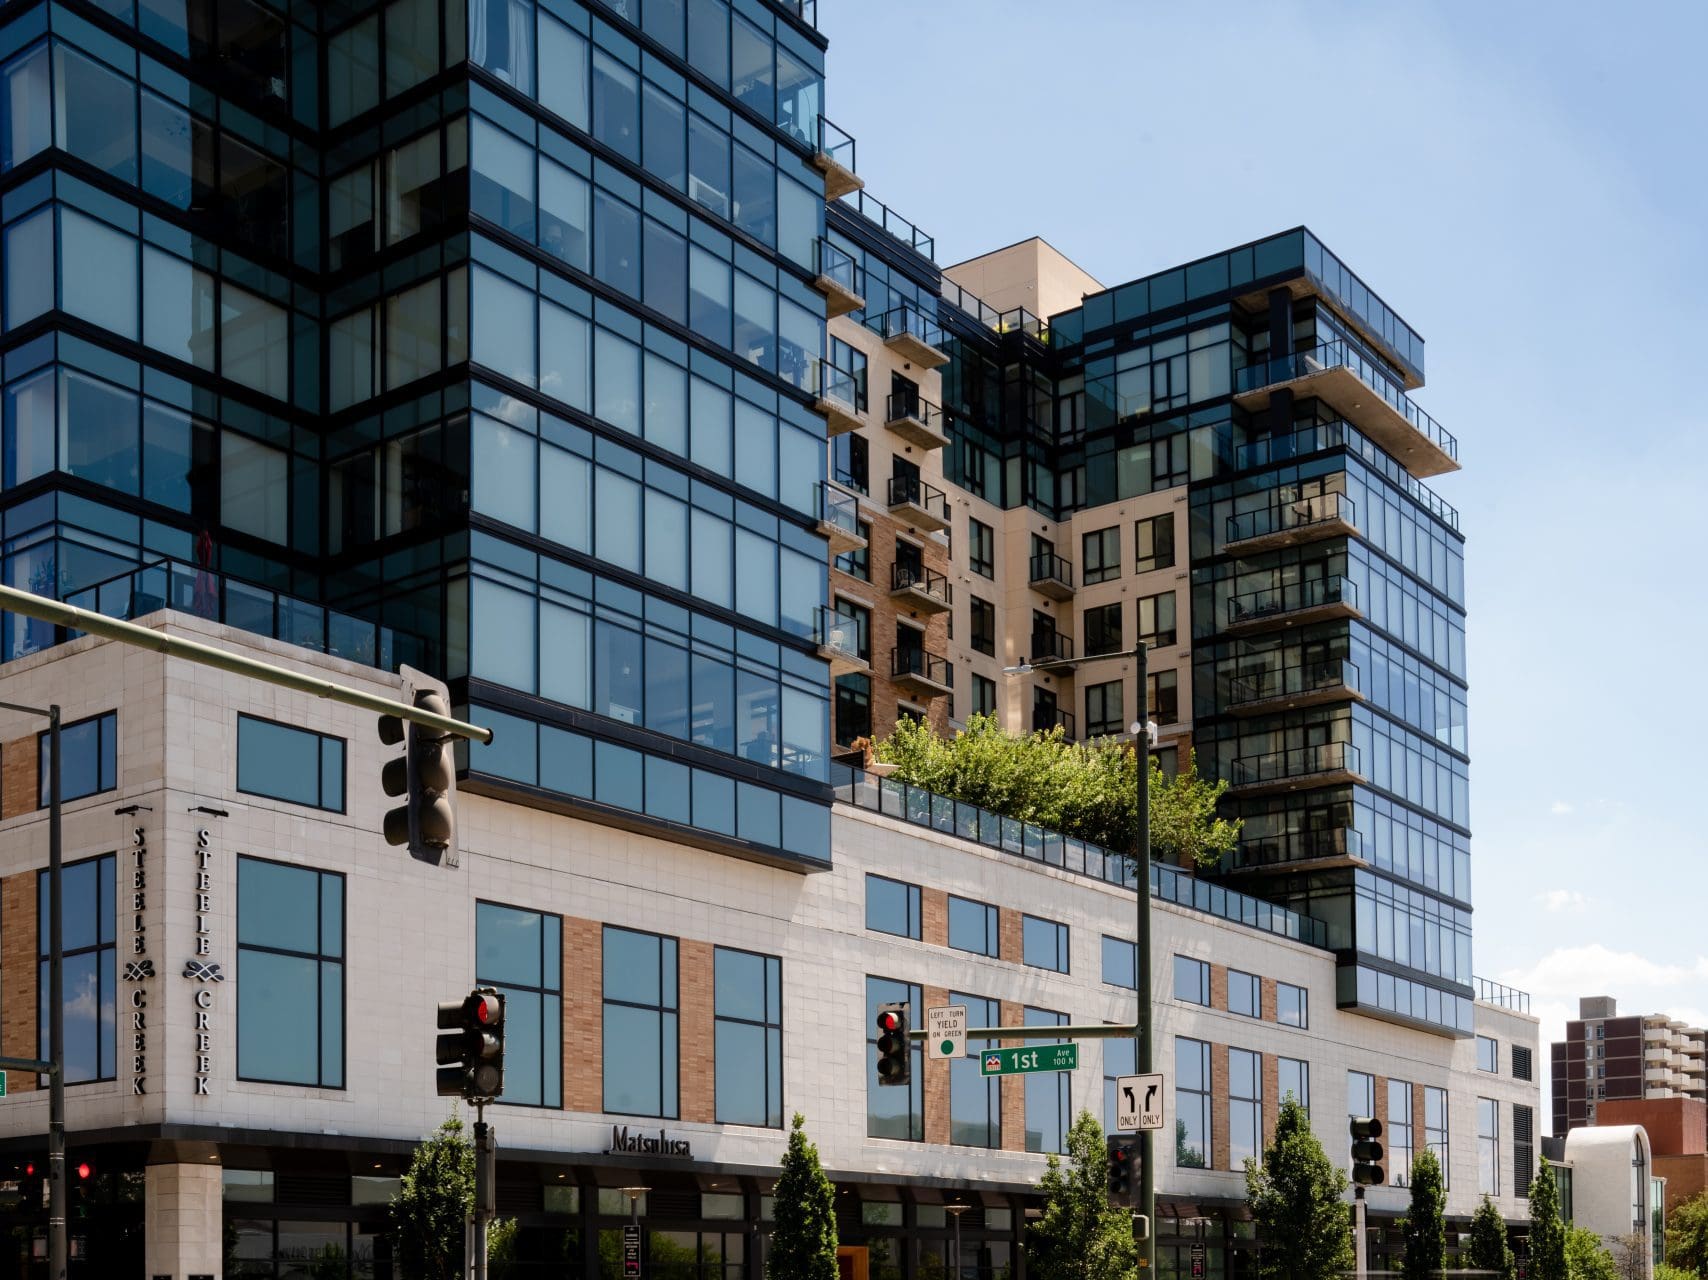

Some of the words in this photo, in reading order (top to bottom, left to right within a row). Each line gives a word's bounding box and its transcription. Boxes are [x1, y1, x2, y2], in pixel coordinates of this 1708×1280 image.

[131, 828, 147, 955] STEELE
[195, 829, 213, 956] STEELE
[930, 1011, 944, 1019] LEFT
[949, 1010, 964, 1018] TURN
[937, 1020, 958, 1029] YIELD
[944, 1030, 962, 1038] GREEN
[131, 990, 147, 1095] CREEK
[195, 990, 213, 1095] CREEK
[1056, 1049, 1070, 1057] Ave
[1011, 1051, 1038, 1069] 1st
[1053, 1057, 1066, 1066] 100
[1068, 1057, 1074, 1065] N
[1120, 1115, 1137, 1126] ONLY
[1142, 1114, 1160, 1125] ONLY
